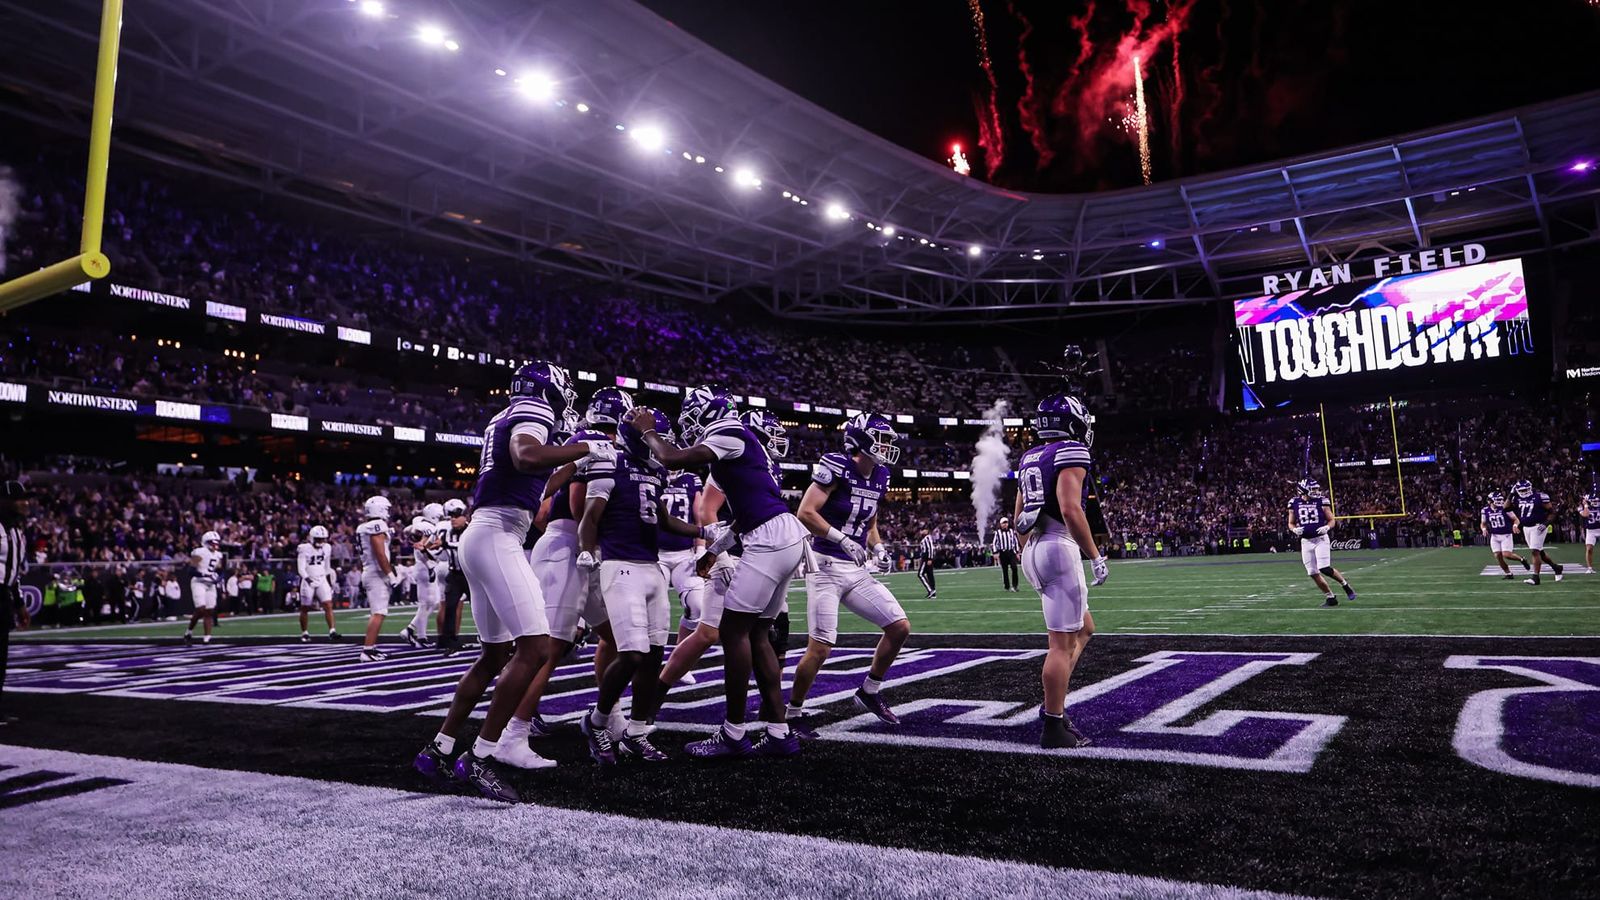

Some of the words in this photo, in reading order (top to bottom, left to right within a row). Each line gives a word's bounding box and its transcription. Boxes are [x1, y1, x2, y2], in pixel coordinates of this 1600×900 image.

[1262, 263, 1351, 296] RYAN
[1373, 243, 1487, 278] FIELD
[109, 283, 190, 309] NORTHWESTERN
[260, 313, 325, 334] NORTHWESTERN
[1256, 302, 1501, 383] TOUCHDOWN
[48, 391, 138, 412] NORTHWESTERN
[321, 420, 382, 436] NORTHWESTERN
[1036, 416, 1049, 428] 19
[638, 483, 658, 525] 6
[660, 493, 690, 523] 73
[1518, 503, 1535, 518] 77
[841, 496, 879, 537] 17
[1298, 507, 1319, 525] 83
[1489, 515, 1505, 528] 60
[208, 559, 217, 573] 5
